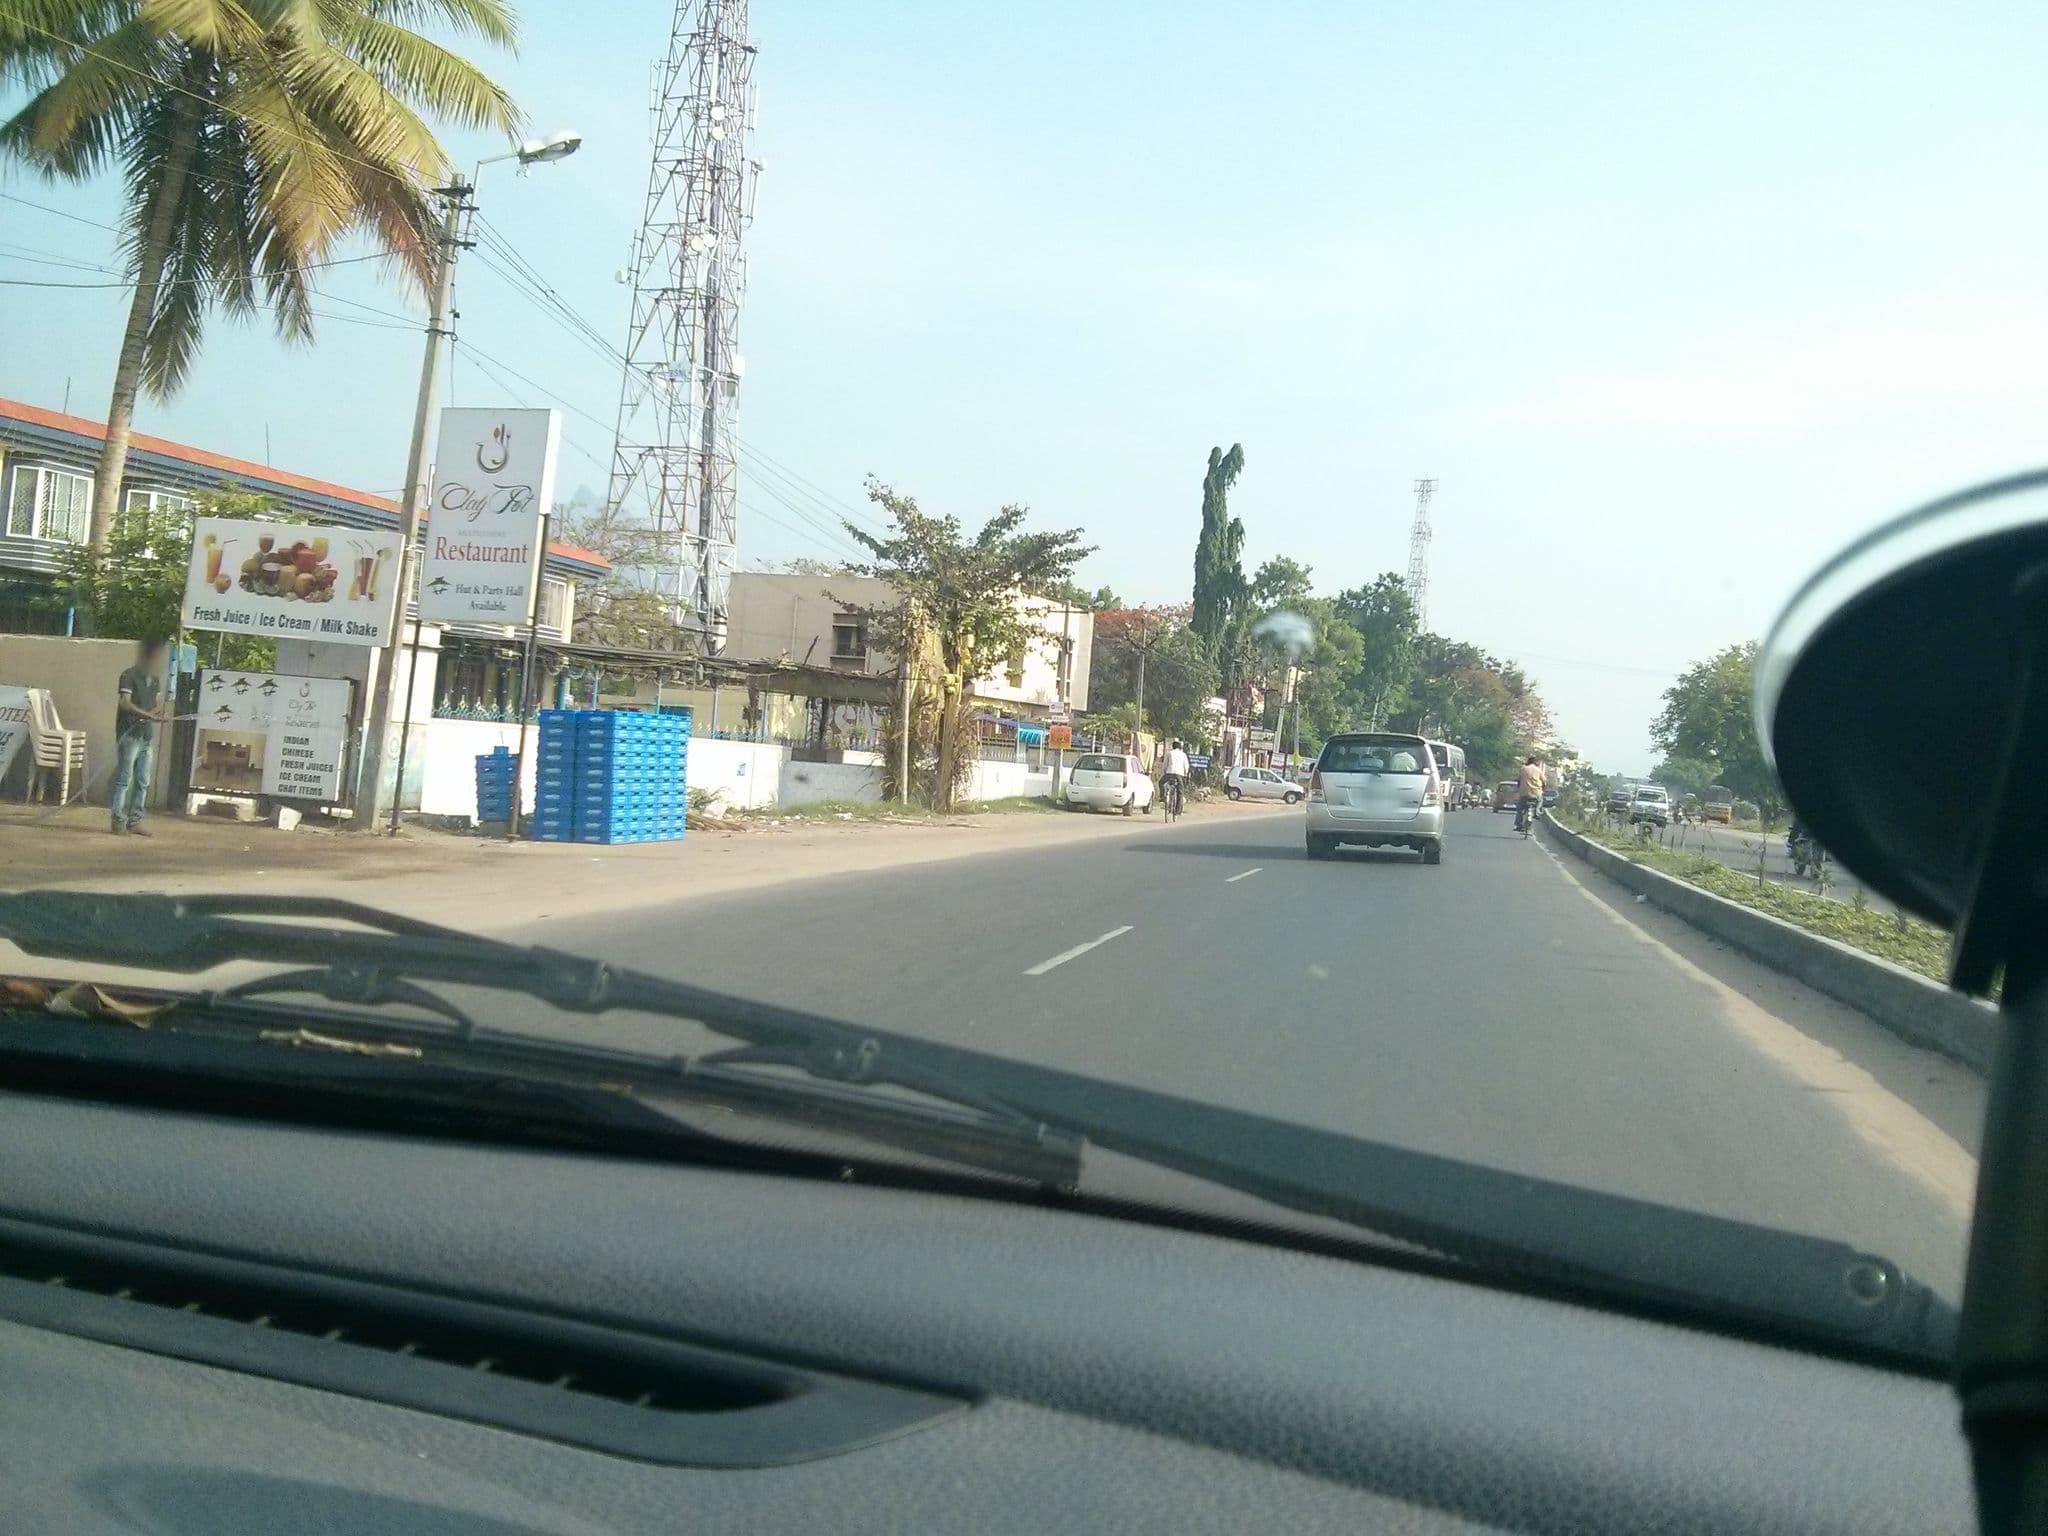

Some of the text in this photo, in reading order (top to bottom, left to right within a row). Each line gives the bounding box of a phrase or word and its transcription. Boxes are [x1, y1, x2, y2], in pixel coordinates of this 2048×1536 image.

[435, 536, 528, 563] Restaurant
[455, 584, 472, 595] Hut
[473, 585, 480, 594] &
[505, 586, 524, 597] Hall
[469, 600, 507, 611] Available
[193, 606, 220, 622] Fresh
[223, 610, 250, 625] Juice
[259, 612, 274, 627] Ice
[278, 614, 311, 630] Cream
[321, 618, 343, 634] Milk
[346, 621, 377, 637] Shake
[283, 736, 309, 745] INDIAN
[282, 748, 314, 759] CHINESE
[280, 760, 333, 773] FRESH JUICES
[279, 772, 321, 783] ICE CREAM
[278, 784, 323, 796] CHAT ITEMS
